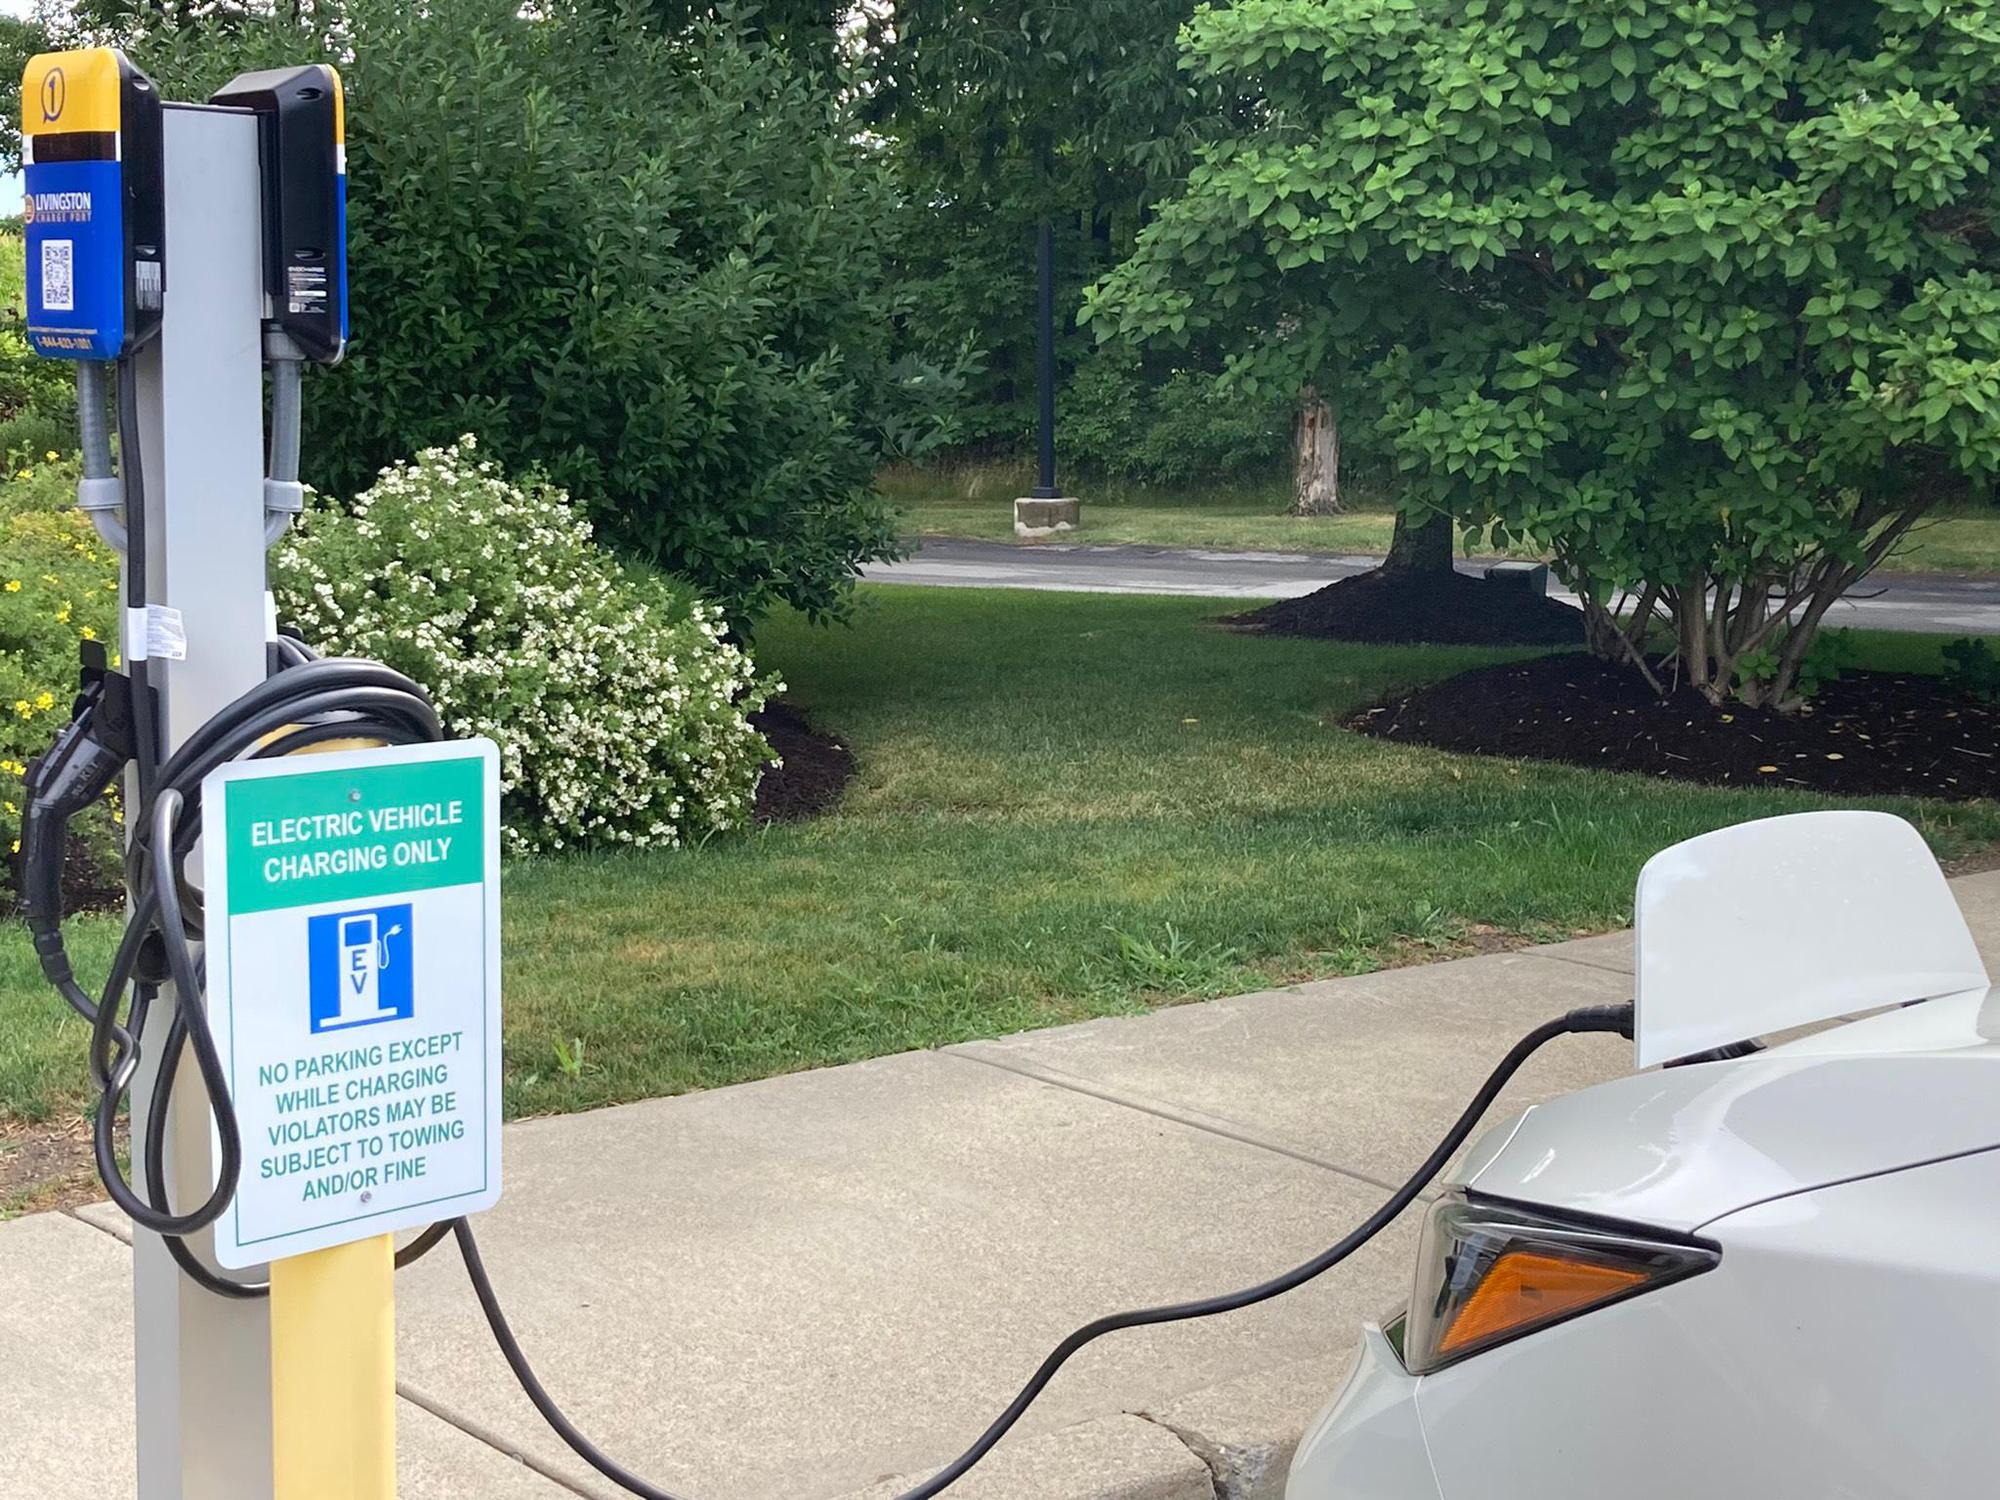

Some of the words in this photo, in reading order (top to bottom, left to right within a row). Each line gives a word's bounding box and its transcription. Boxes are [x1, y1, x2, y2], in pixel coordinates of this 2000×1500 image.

[36, 192, 91, 211] LIVINGSTON
[252, 811, 363, 847] ELECTRIC
[368, 800, 463, 832] VEHICLE
[264, 845, 387, 882] CHARGING
[393, 837, 452, 866] ONLY
[259, 1062, 289, 1087] NO
[295, 1046, 382, 1080] PARKING
[389, 1031, 463, 1063] EXCEPT
[276, 1083, 340, 1114] WHILE
[345, 1064, 448, 1100] CHARGING
[268, 1106, 380, 1146] VIOLATORS
[386, 1097, 426, 1123] MAY
[431, 1091, 456, 1115] BE
[261, 1142, 352, 1179] SUBJECT
[357, 1136, 383, 1159] TO
[389, 1120, 464, 1152] TOWING
[302, 1167, 378, 1201] AND/OR
[384, 1156, 426, 1183] FINE
